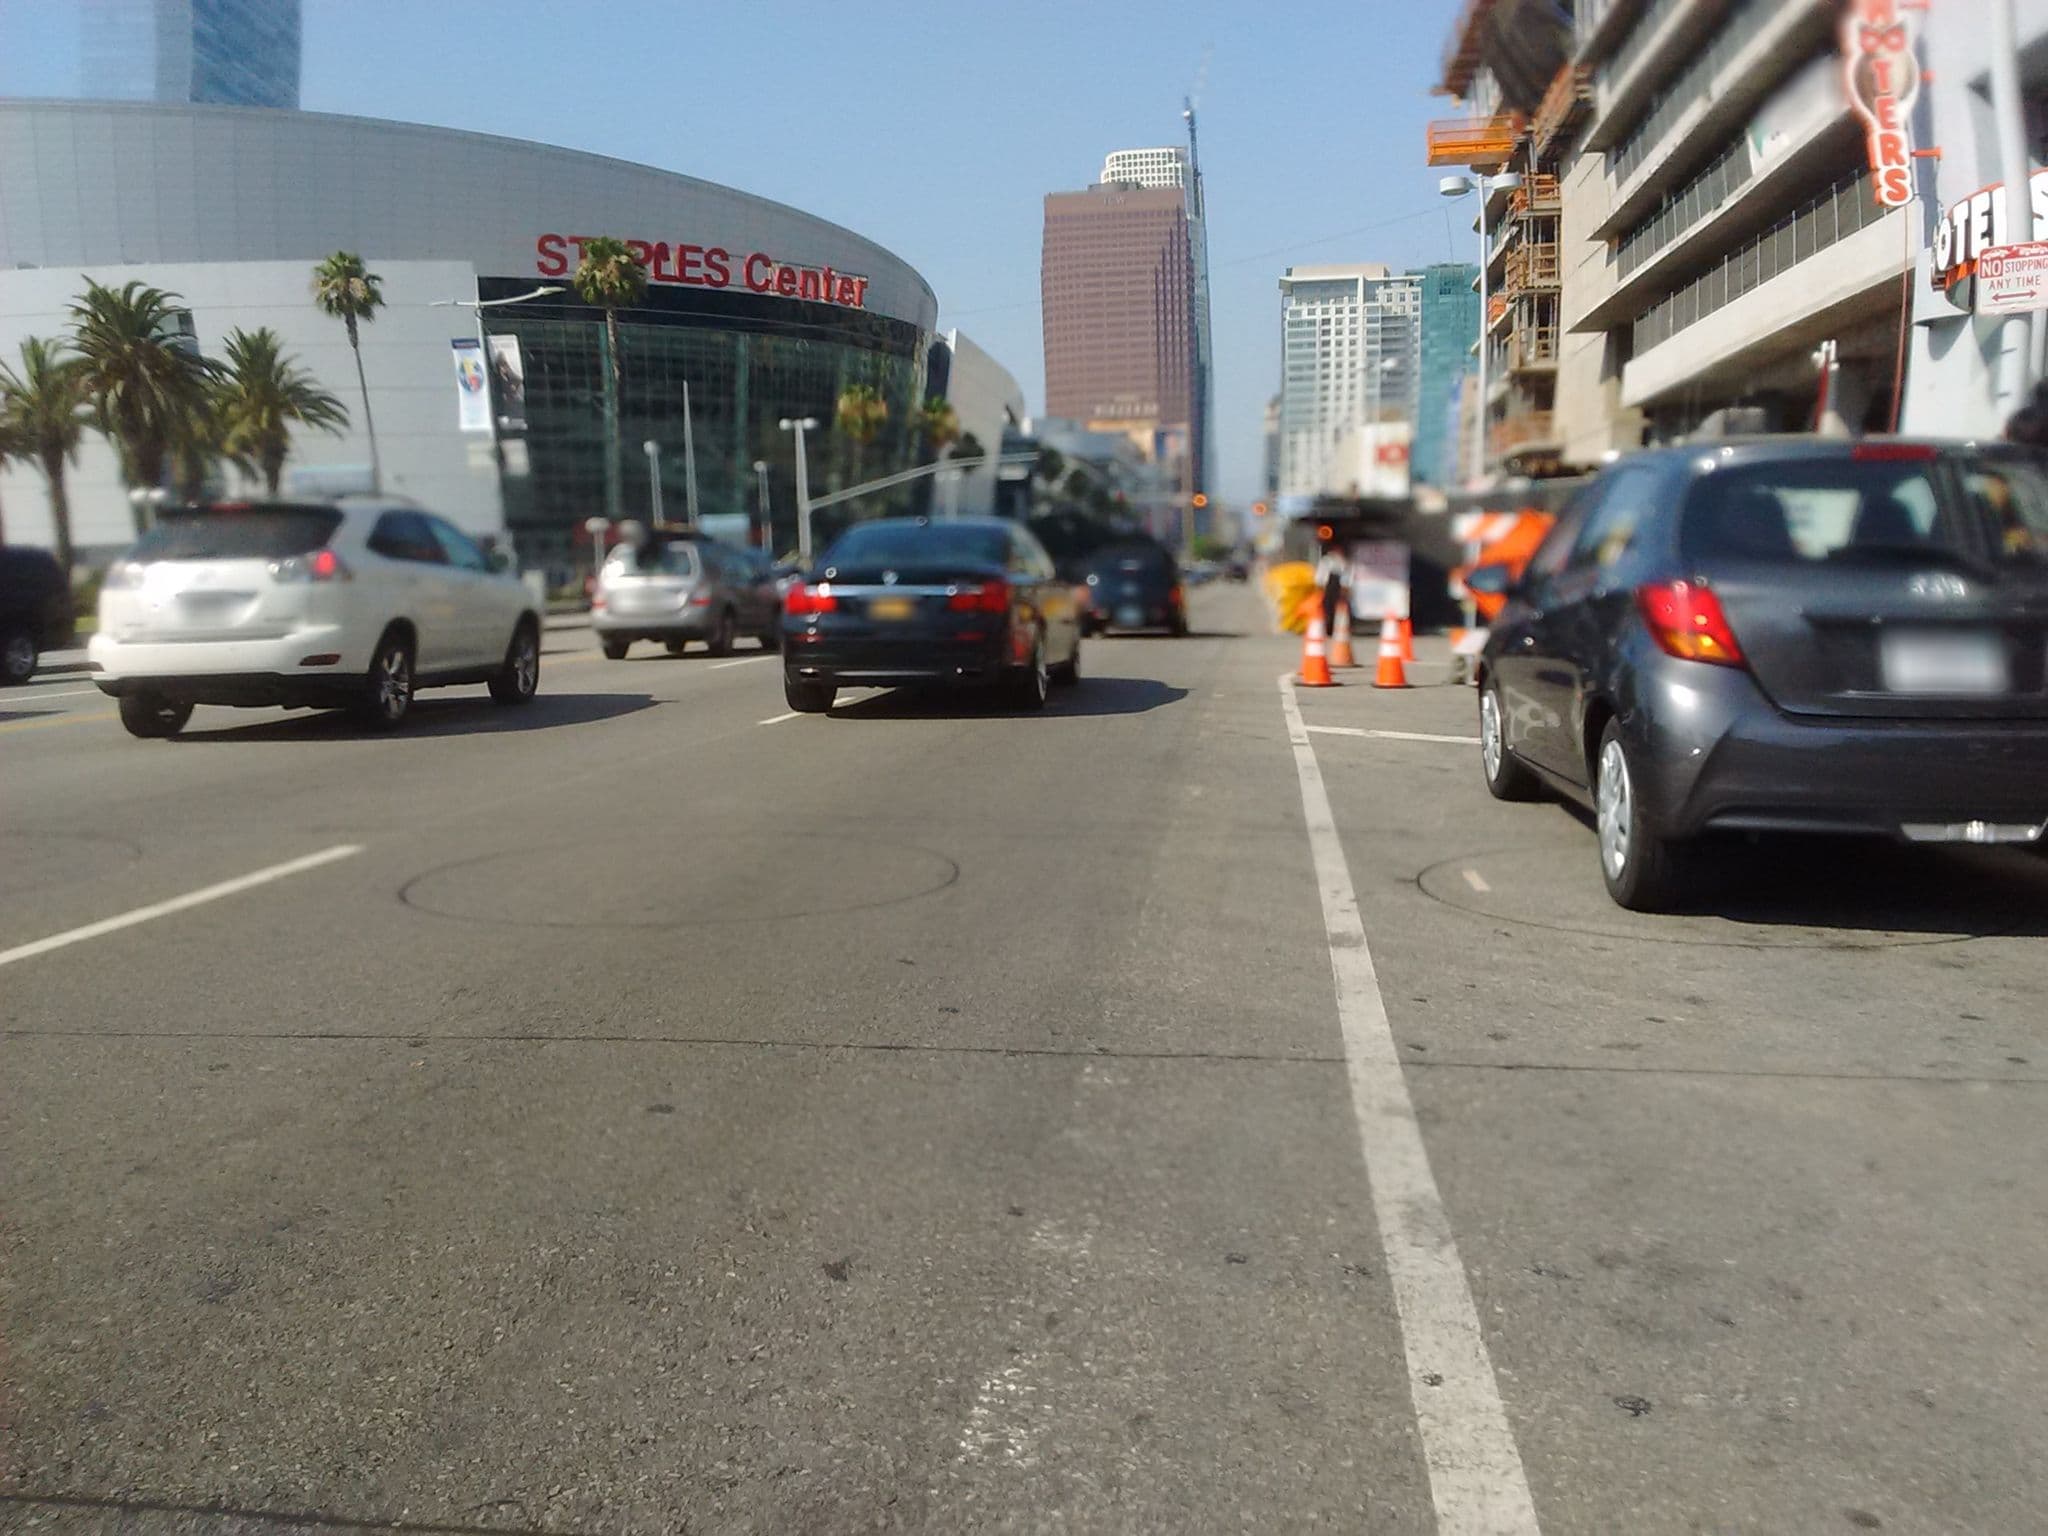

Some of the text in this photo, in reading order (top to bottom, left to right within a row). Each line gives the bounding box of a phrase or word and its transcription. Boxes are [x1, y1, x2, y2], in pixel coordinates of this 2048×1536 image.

[536, 233, 868, 308] STPLES Center
[1981, 258, 2048, 277] NO STOPPING
[1989, 275, 2041, 291] ANY TIME
